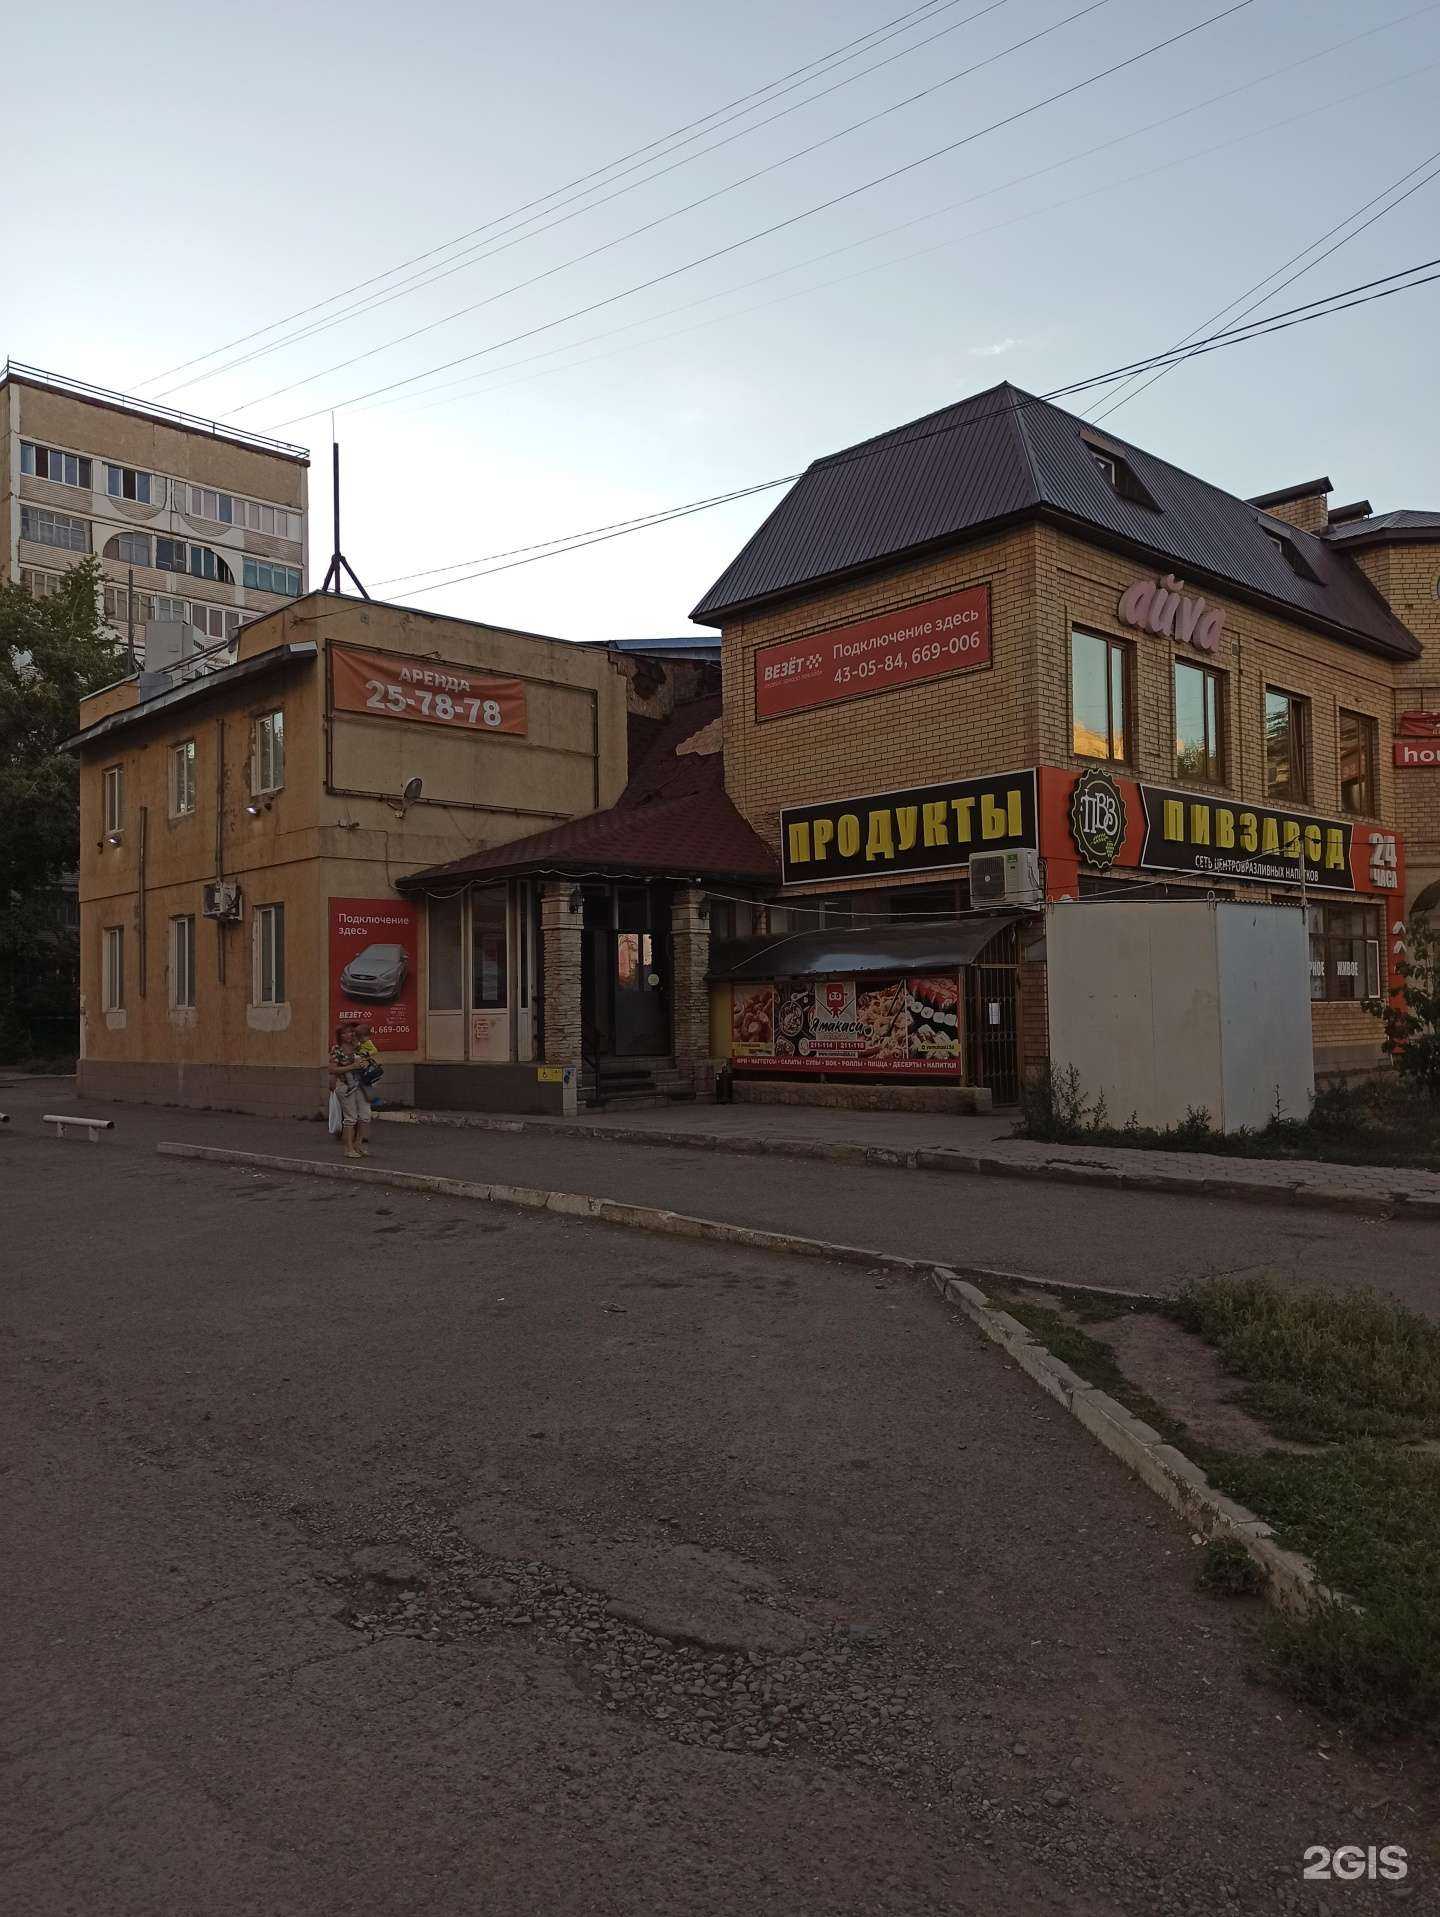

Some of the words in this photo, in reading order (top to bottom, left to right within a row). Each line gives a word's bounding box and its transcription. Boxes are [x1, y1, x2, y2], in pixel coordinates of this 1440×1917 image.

[832, 620, 932, 660] Подключение
[935, 609, 979, 631] здесь
[832, 652, 908, 685] 43-05-84,
[911, 630, 981, 665] 669-006
[764, 655, 805, 682] ВЕЗЁТ
[399, 667, 471, 693] АРЕНДА
[365, 679, 502, 727] 25-78-78
[1404, 746, 1440, 763] ho
[788, 789, 1023, 864] ПРОДУКТЫ
[1163, 799, 1345, 871] ПИВЗАВОД
[1368, 832, 1397, 868] 24
[1195, 854, 1213, 869] СЕТЬ
[1369, 868, 1398, 889] ЧАСА
[338, 913, 409, 925] Подключение
[338, 927, 368, 937] здесь
[1336, 960, 1359, 977] ЖИВОЕ
[378, 1025, 410, 1034] 669-006
[809, 1017, 864, 1034] Ямакаси
[781, 1058, 802, 1066] САЛАТЫ
[841, 1059, 863, 1067] РОЛЛЫ
[867, 1060, 888, 1068] ПИЦЦА
[892, 1060, 922, 1069] ДЕСЕРТЫ
[926, 1060, 957, 1069] НАПИТКИ
